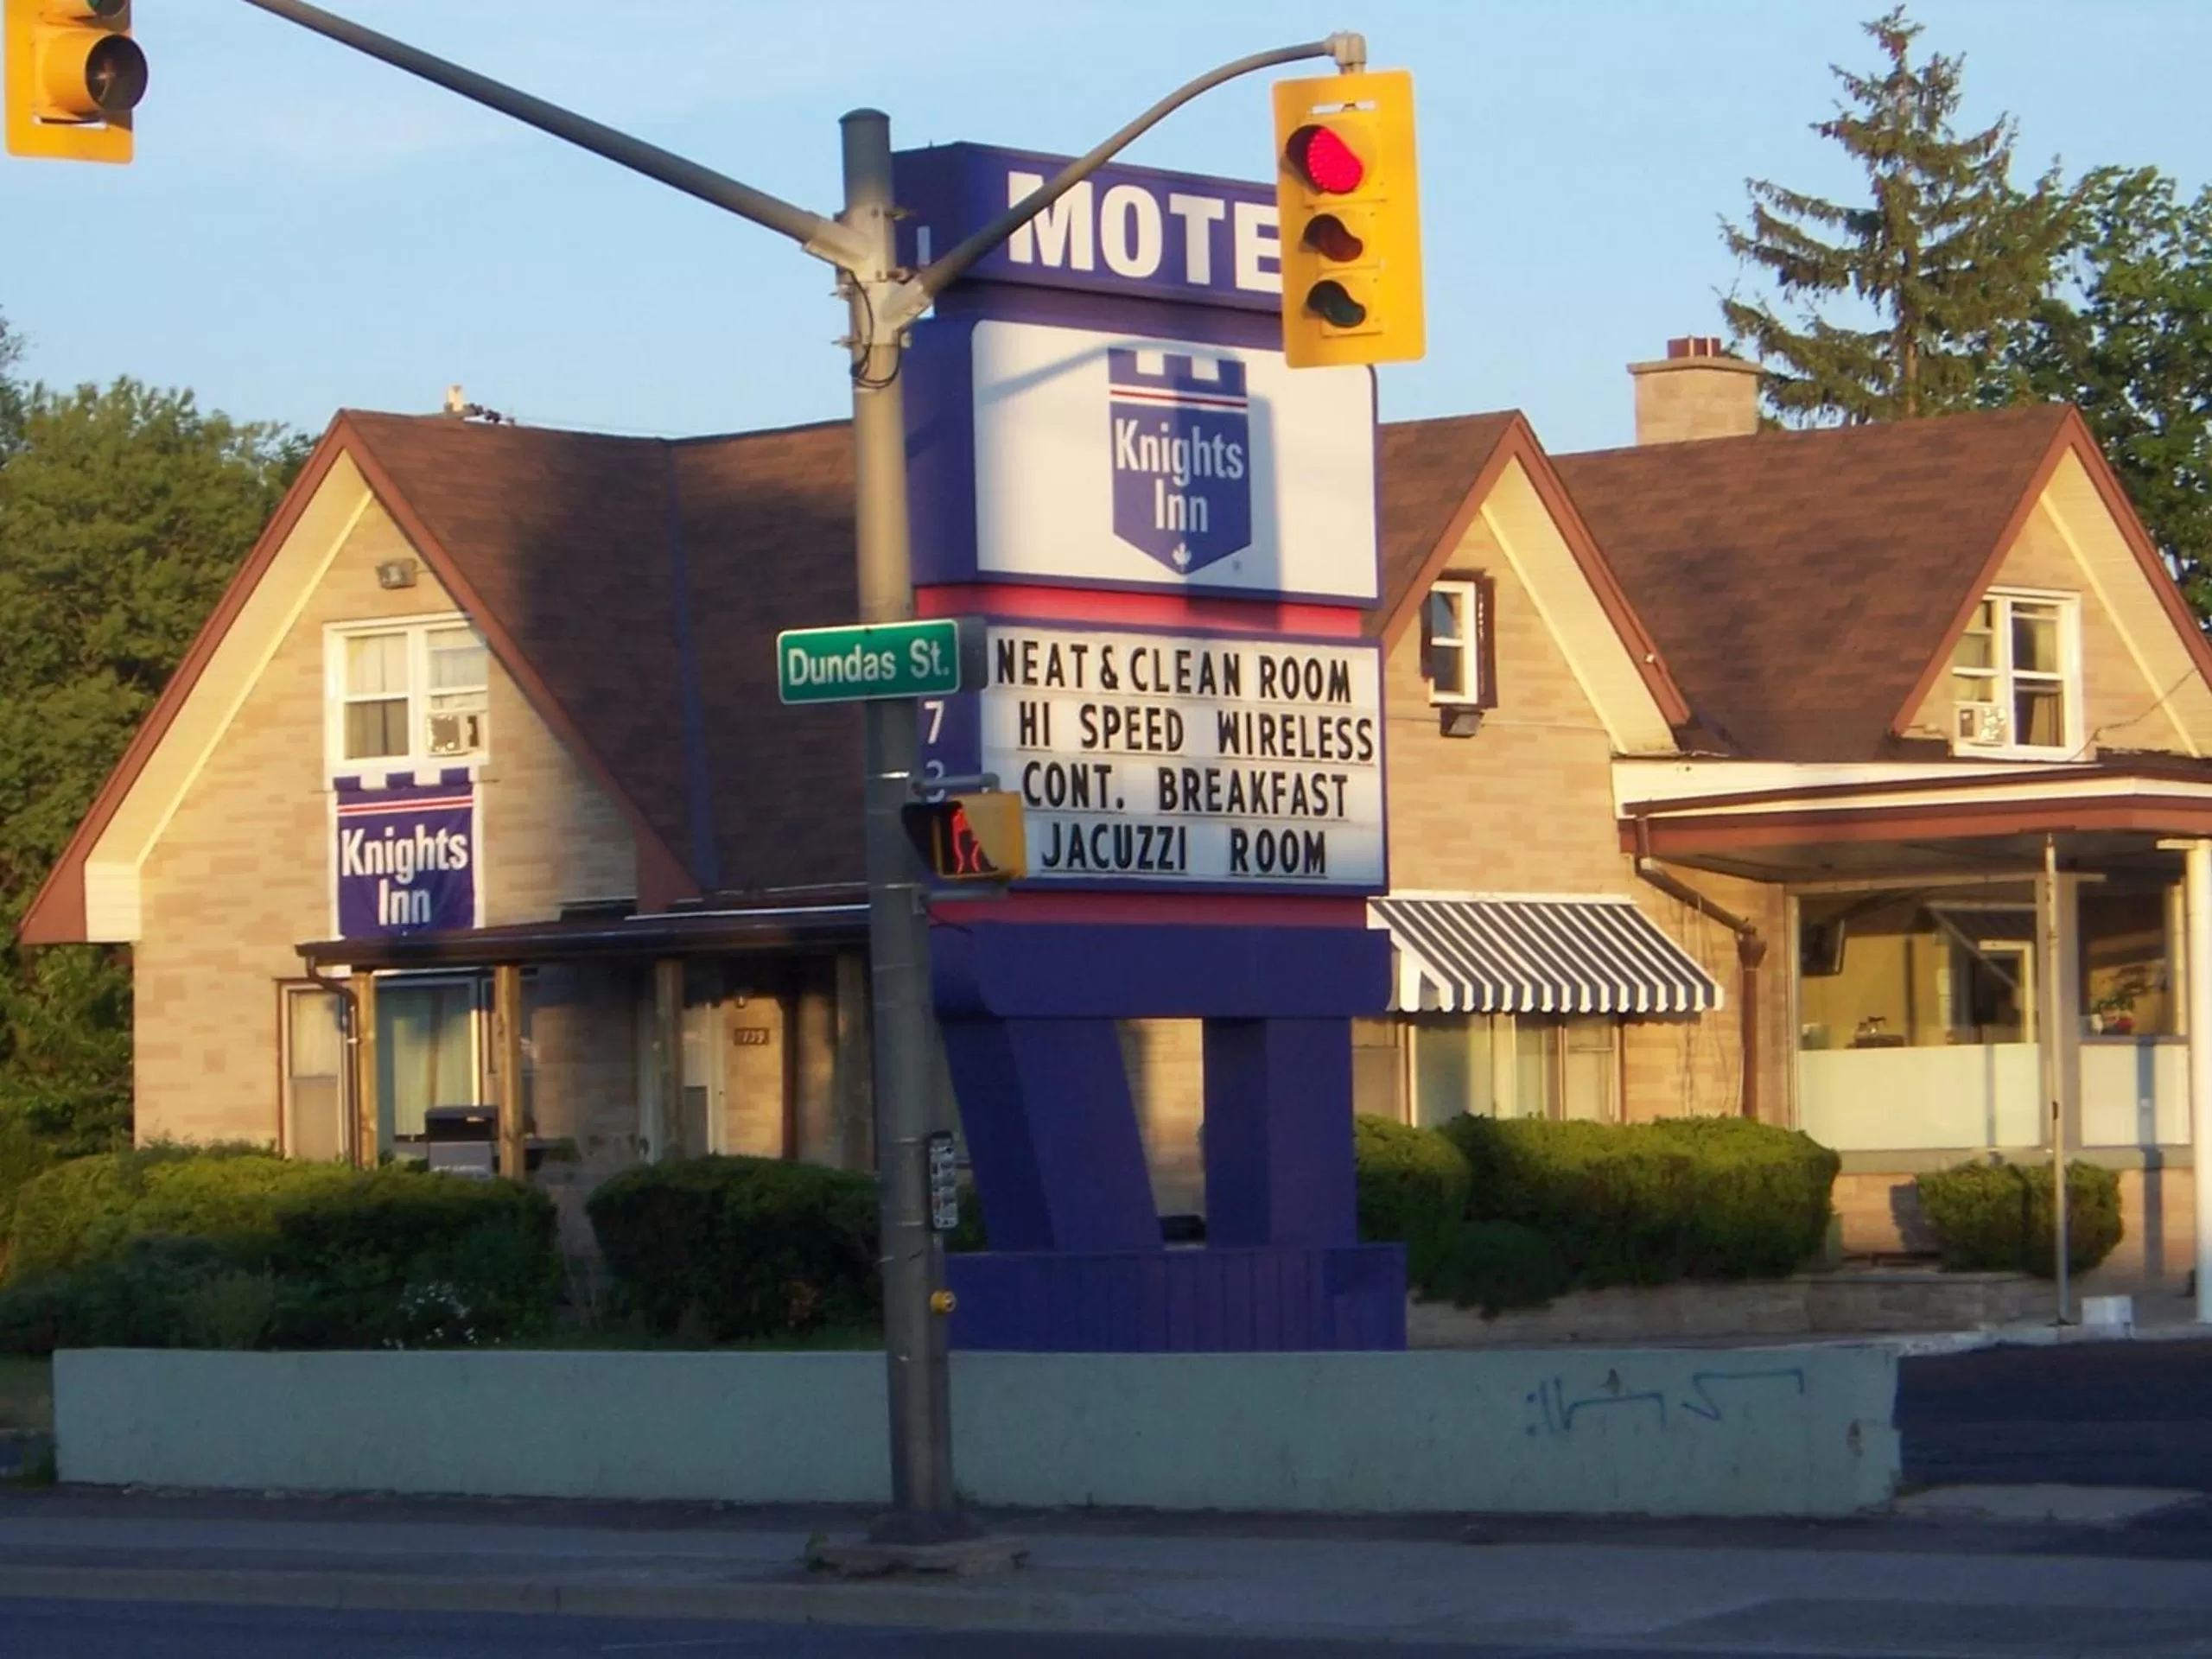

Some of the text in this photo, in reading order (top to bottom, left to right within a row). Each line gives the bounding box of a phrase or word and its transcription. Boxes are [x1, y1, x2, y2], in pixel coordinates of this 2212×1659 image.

[1007, 170, 1284, 294] MOTE
[1115, 418, 1244, 487] Knights
[1154, 478, 1209, 532] Inn
[787, 638, 950, 686] Dundas St.
[1259, 655, 1351, 703] ROOM
[1020, 701, 1374, 762] HI SPEED WIRELESS
[1023, 760, 1348, 817] CONT. BREAKFAST
[341, 823, 469, 885] Knights
[1041, 822, 1325, 874] JACUZZI ROOM
[378, 878, 432, 926] Inn
